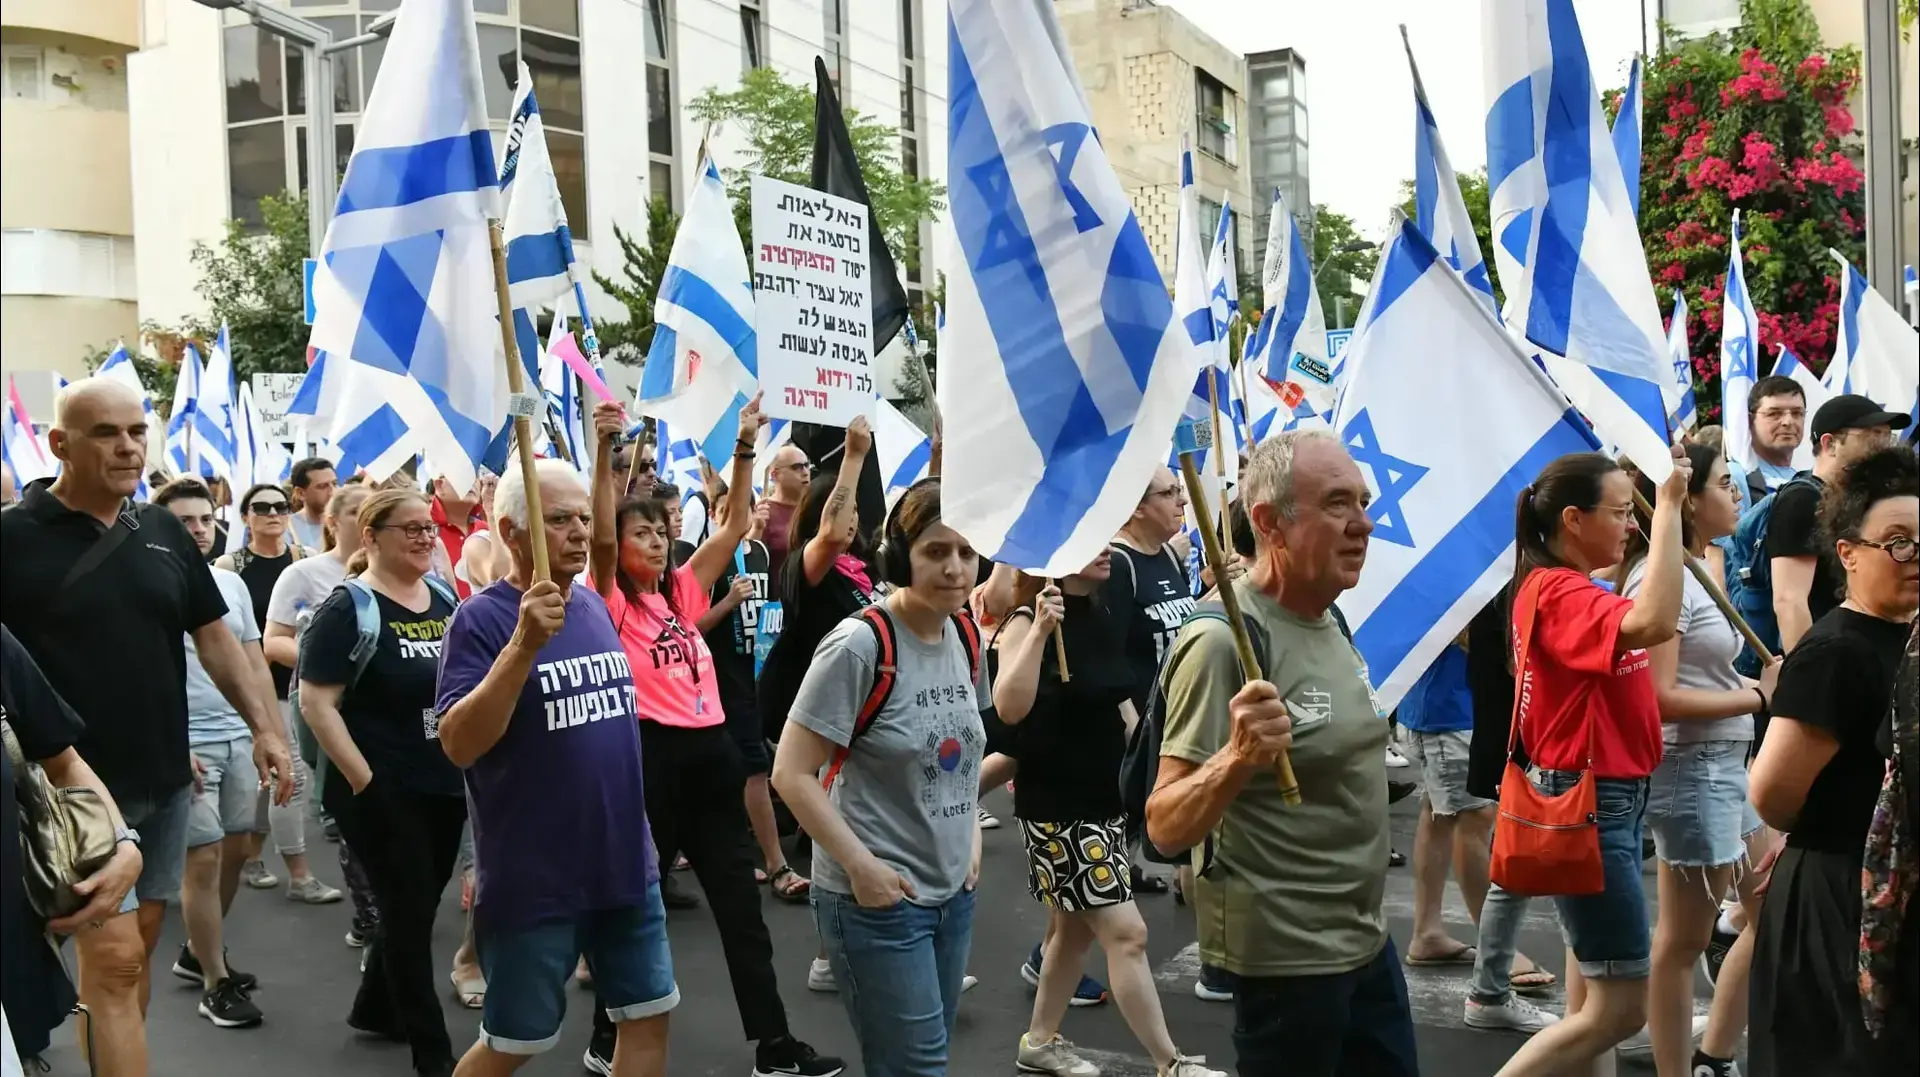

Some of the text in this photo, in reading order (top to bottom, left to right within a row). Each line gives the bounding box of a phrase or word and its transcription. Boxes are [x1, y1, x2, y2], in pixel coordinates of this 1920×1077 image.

[777, 194, 861, 229] האלימות
[787, 222, 812, 241] את
[761, 244, 866, 279] יסוד הדמוקרטיה
[806, 282, 835, 303] עמיר
[839, 286, 863, 308] יגאל
[831, 342, 868, 366] מנסה
[816, 367, 872, 393] לה וידוא
[784, 387, 828, 410] הריגה
[537, 651, 633, 694] מוקרטיה
[916, 685, 969, 708] 대한민국
[544, 687, 625, 731] בנפשנו
